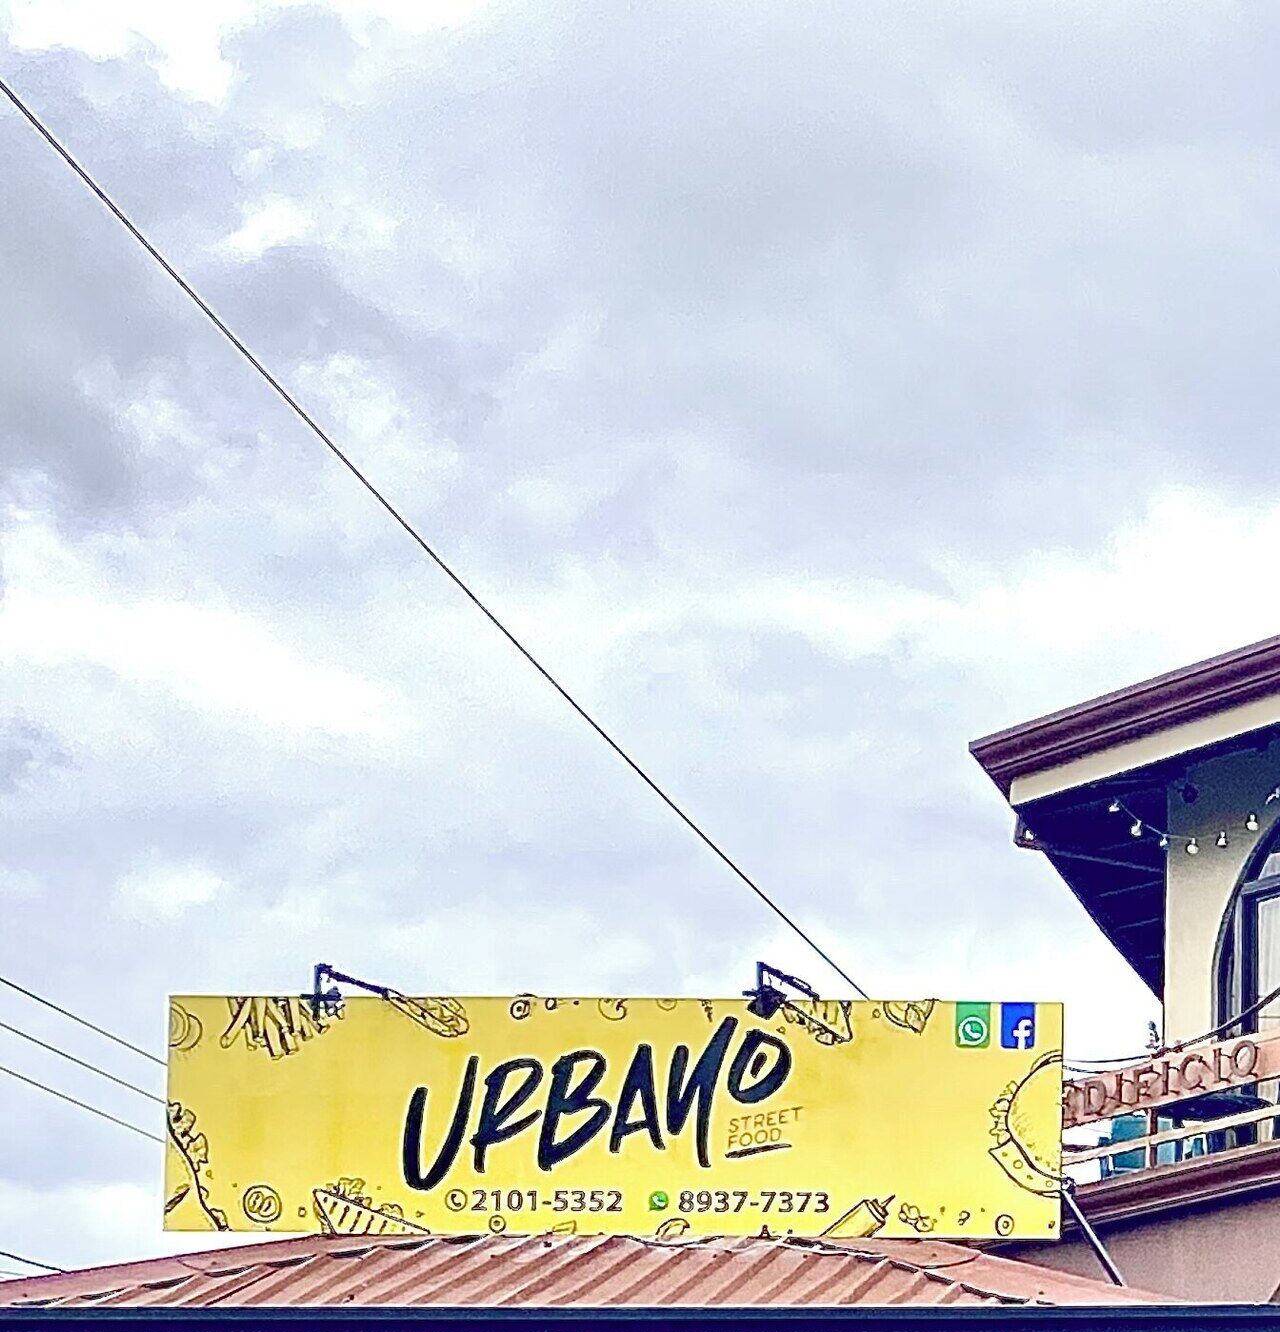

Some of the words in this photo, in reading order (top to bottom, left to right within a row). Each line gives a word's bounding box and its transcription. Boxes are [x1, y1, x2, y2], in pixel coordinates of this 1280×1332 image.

[403, 1016, 792, 1191] URBANO
[728, 1106, 805, 1133] STREET
[727, 1128, 782, 1150] FOOD
[471, 1190, 623, 1213] 2101-5352
[678, 1191, 830, 1214] 8937-7373
